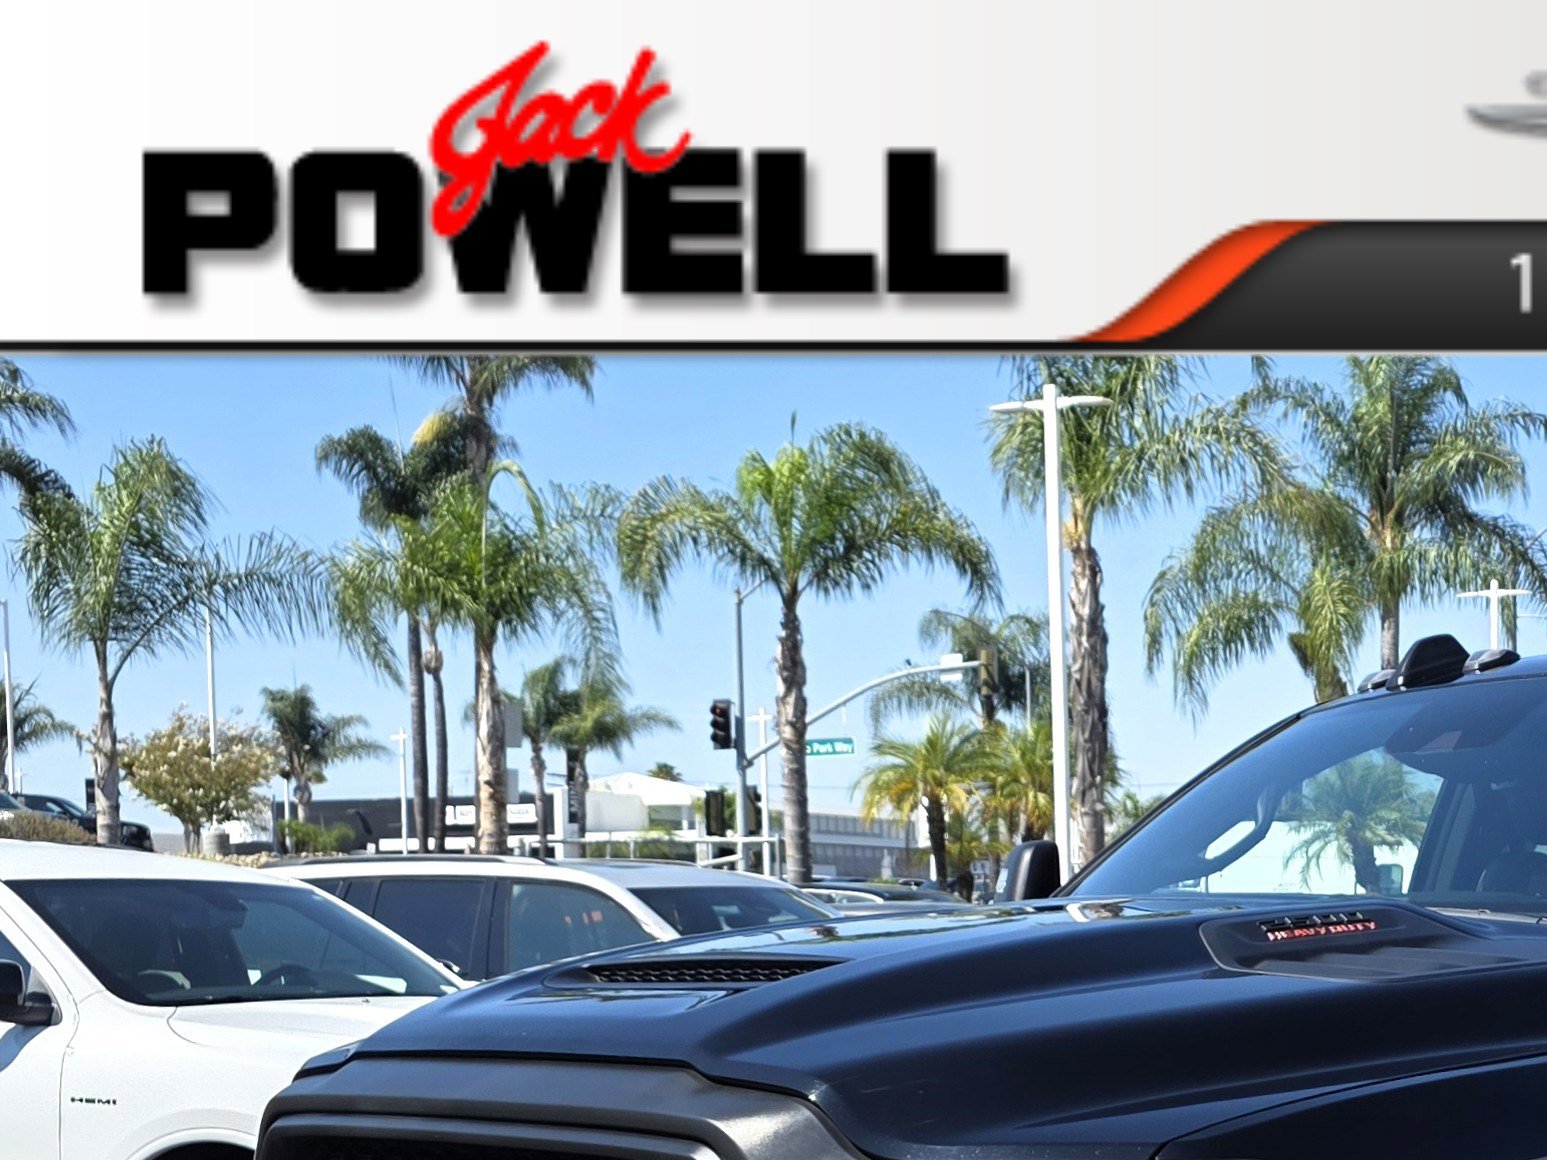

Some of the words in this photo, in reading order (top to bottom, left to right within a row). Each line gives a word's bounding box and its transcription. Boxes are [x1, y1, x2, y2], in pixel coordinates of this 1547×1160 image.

[813, 742, 833, 753] Park
[834, 741, 854, 753] Way
[1328, 921, 1376, 934] DUTY
